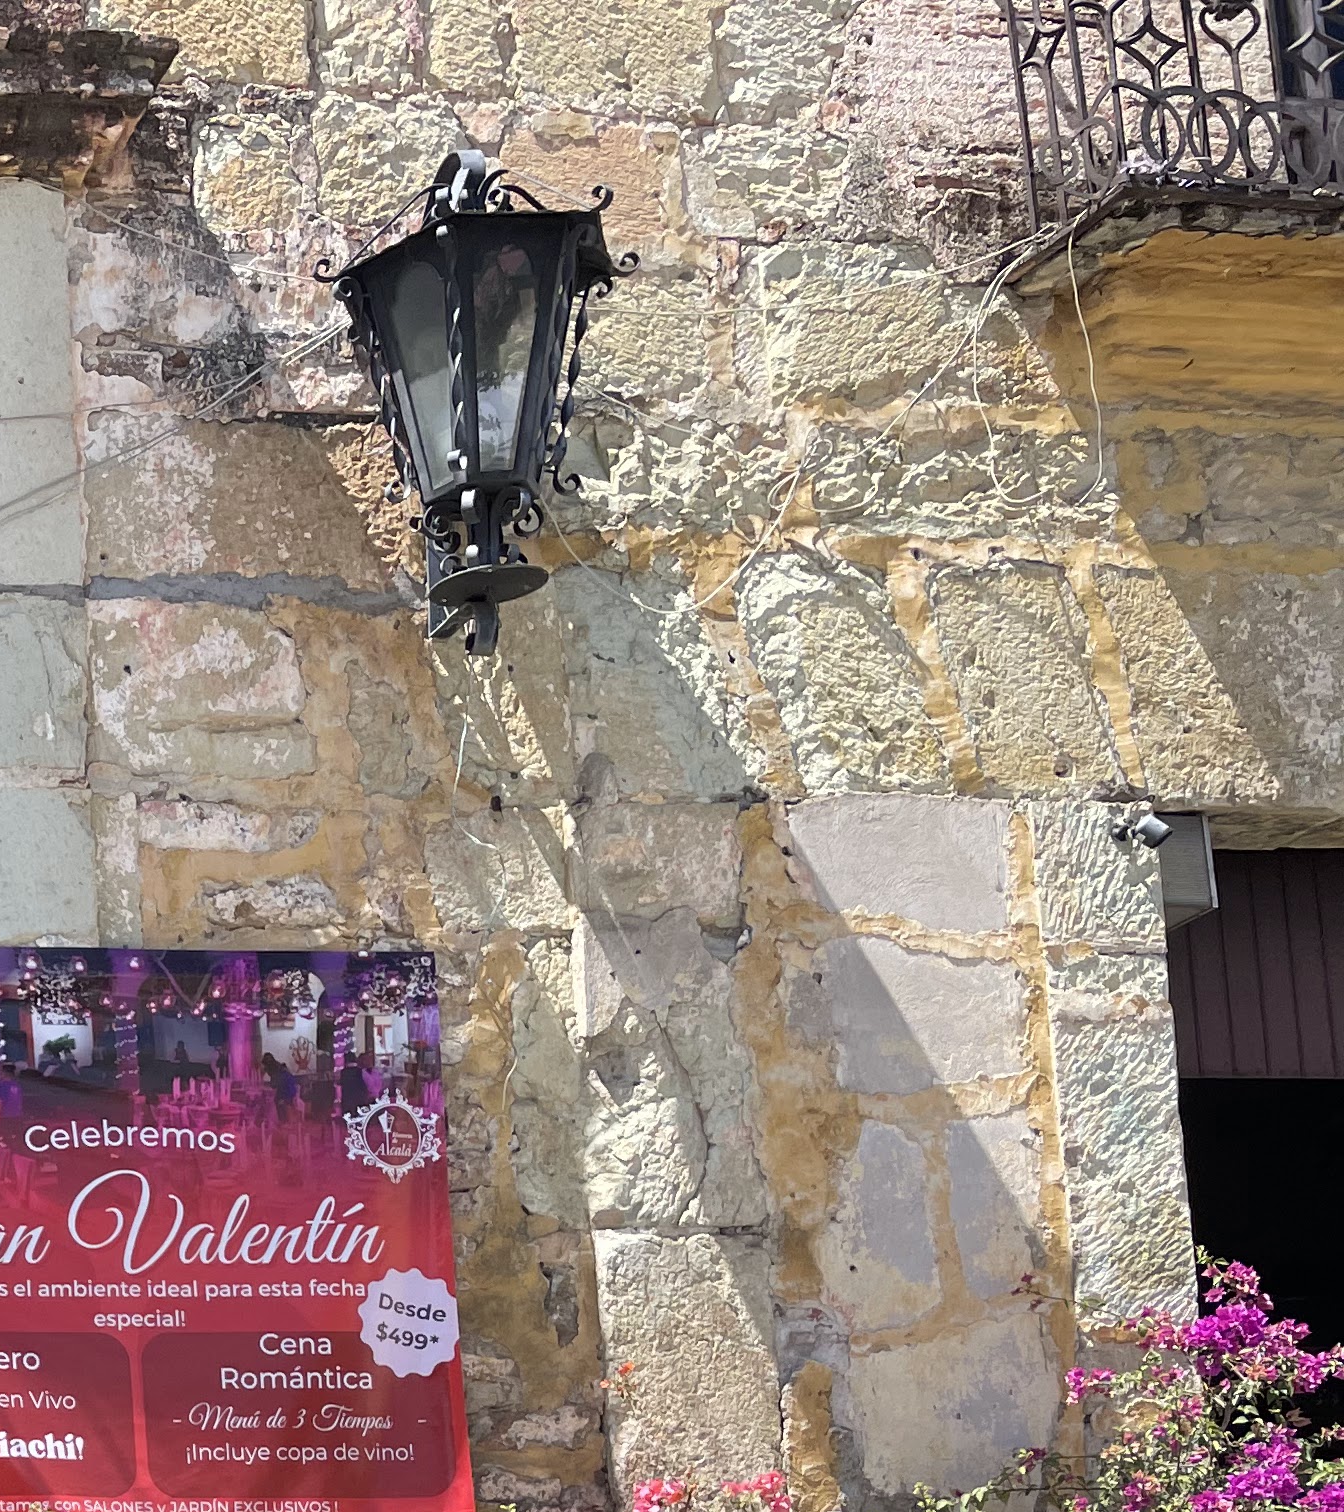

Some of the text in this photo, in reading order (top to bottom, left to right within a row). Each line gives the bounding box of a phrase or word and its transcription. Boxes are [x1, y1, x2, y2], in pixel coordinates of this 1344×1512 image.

[24, 1119, 236, 1153] Celebremos
[67, 1169, 386, 1275] Valentín
[14, 1279, 31, 1297] el
[38, 1279, 141, 1297] ambiente
[148, 1279, 198, 1297] ideal
[205, 1283, 252, 1301] para
[259, 1281, 303, 1297] esta
[309, 1279, 365, 1297] fecha
[378, 1292, 447, 1322] Desde
[94, 1309, 186, 1330] especial!
[259, 1332, 332, 1355] Cena
[220, 1366, 373, 1390] Romántica
[28, 1390, 76, 1410] Vivo
[188, 1402, 393, 1436] Menú de 3 Tiempos
[186, 1443, 415, 1464] ¡Incluye copa de vino!
[54, 1501, 80, 1511] con
